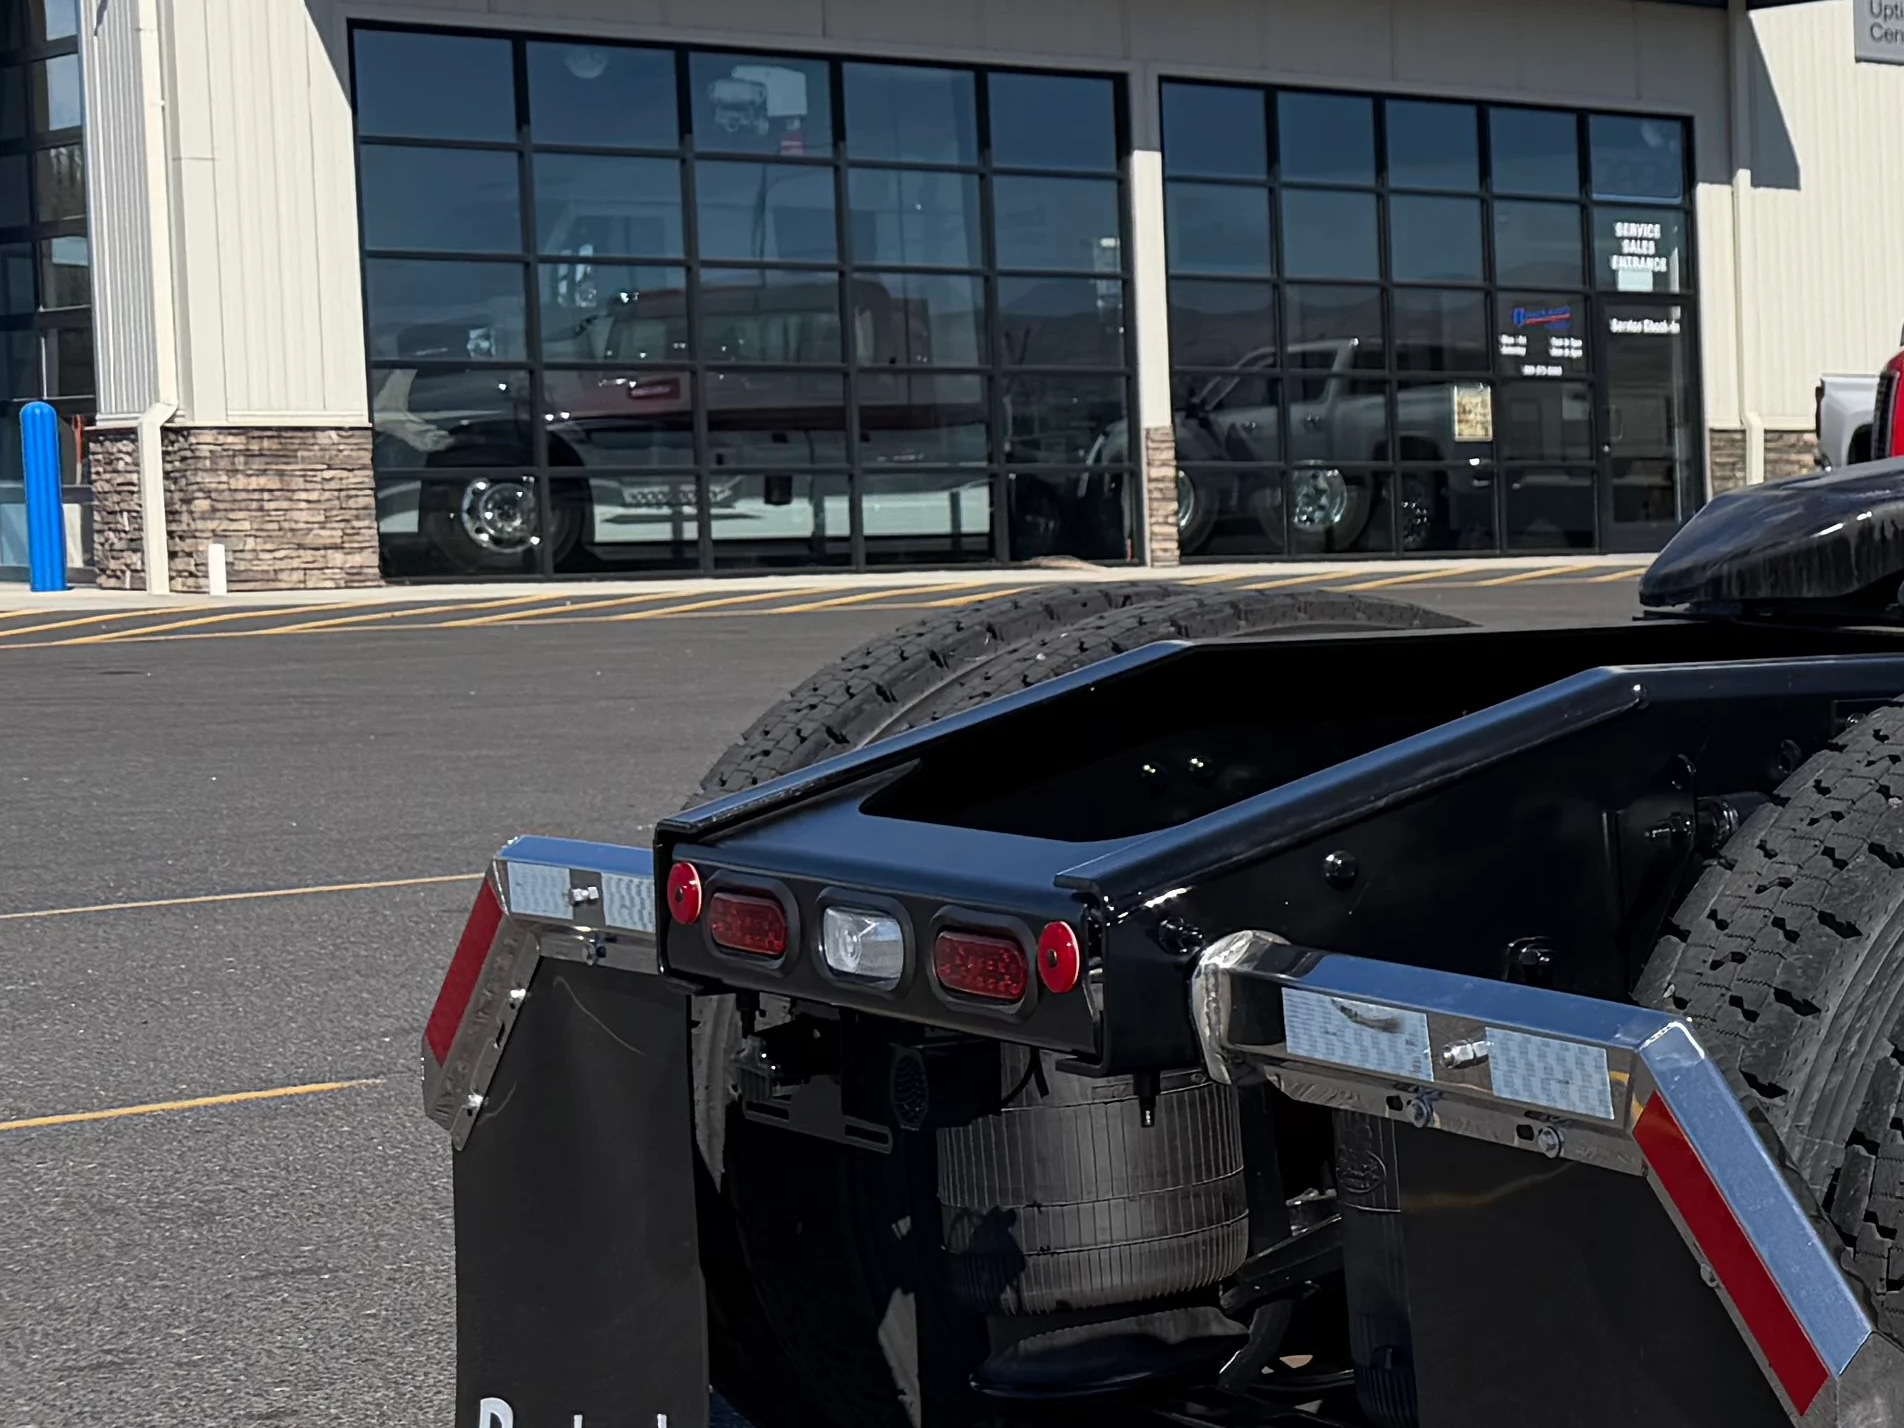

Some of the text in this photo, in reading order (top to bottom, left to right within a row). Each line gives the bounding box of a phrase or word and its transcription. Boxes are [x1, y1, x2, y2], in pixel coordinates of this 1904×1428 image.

[1614, 221, 1661, 240] SERVICE
[1621, 239, 1656, 256] SALES
[1609, 255, 1667, 273] ENTRANCE
